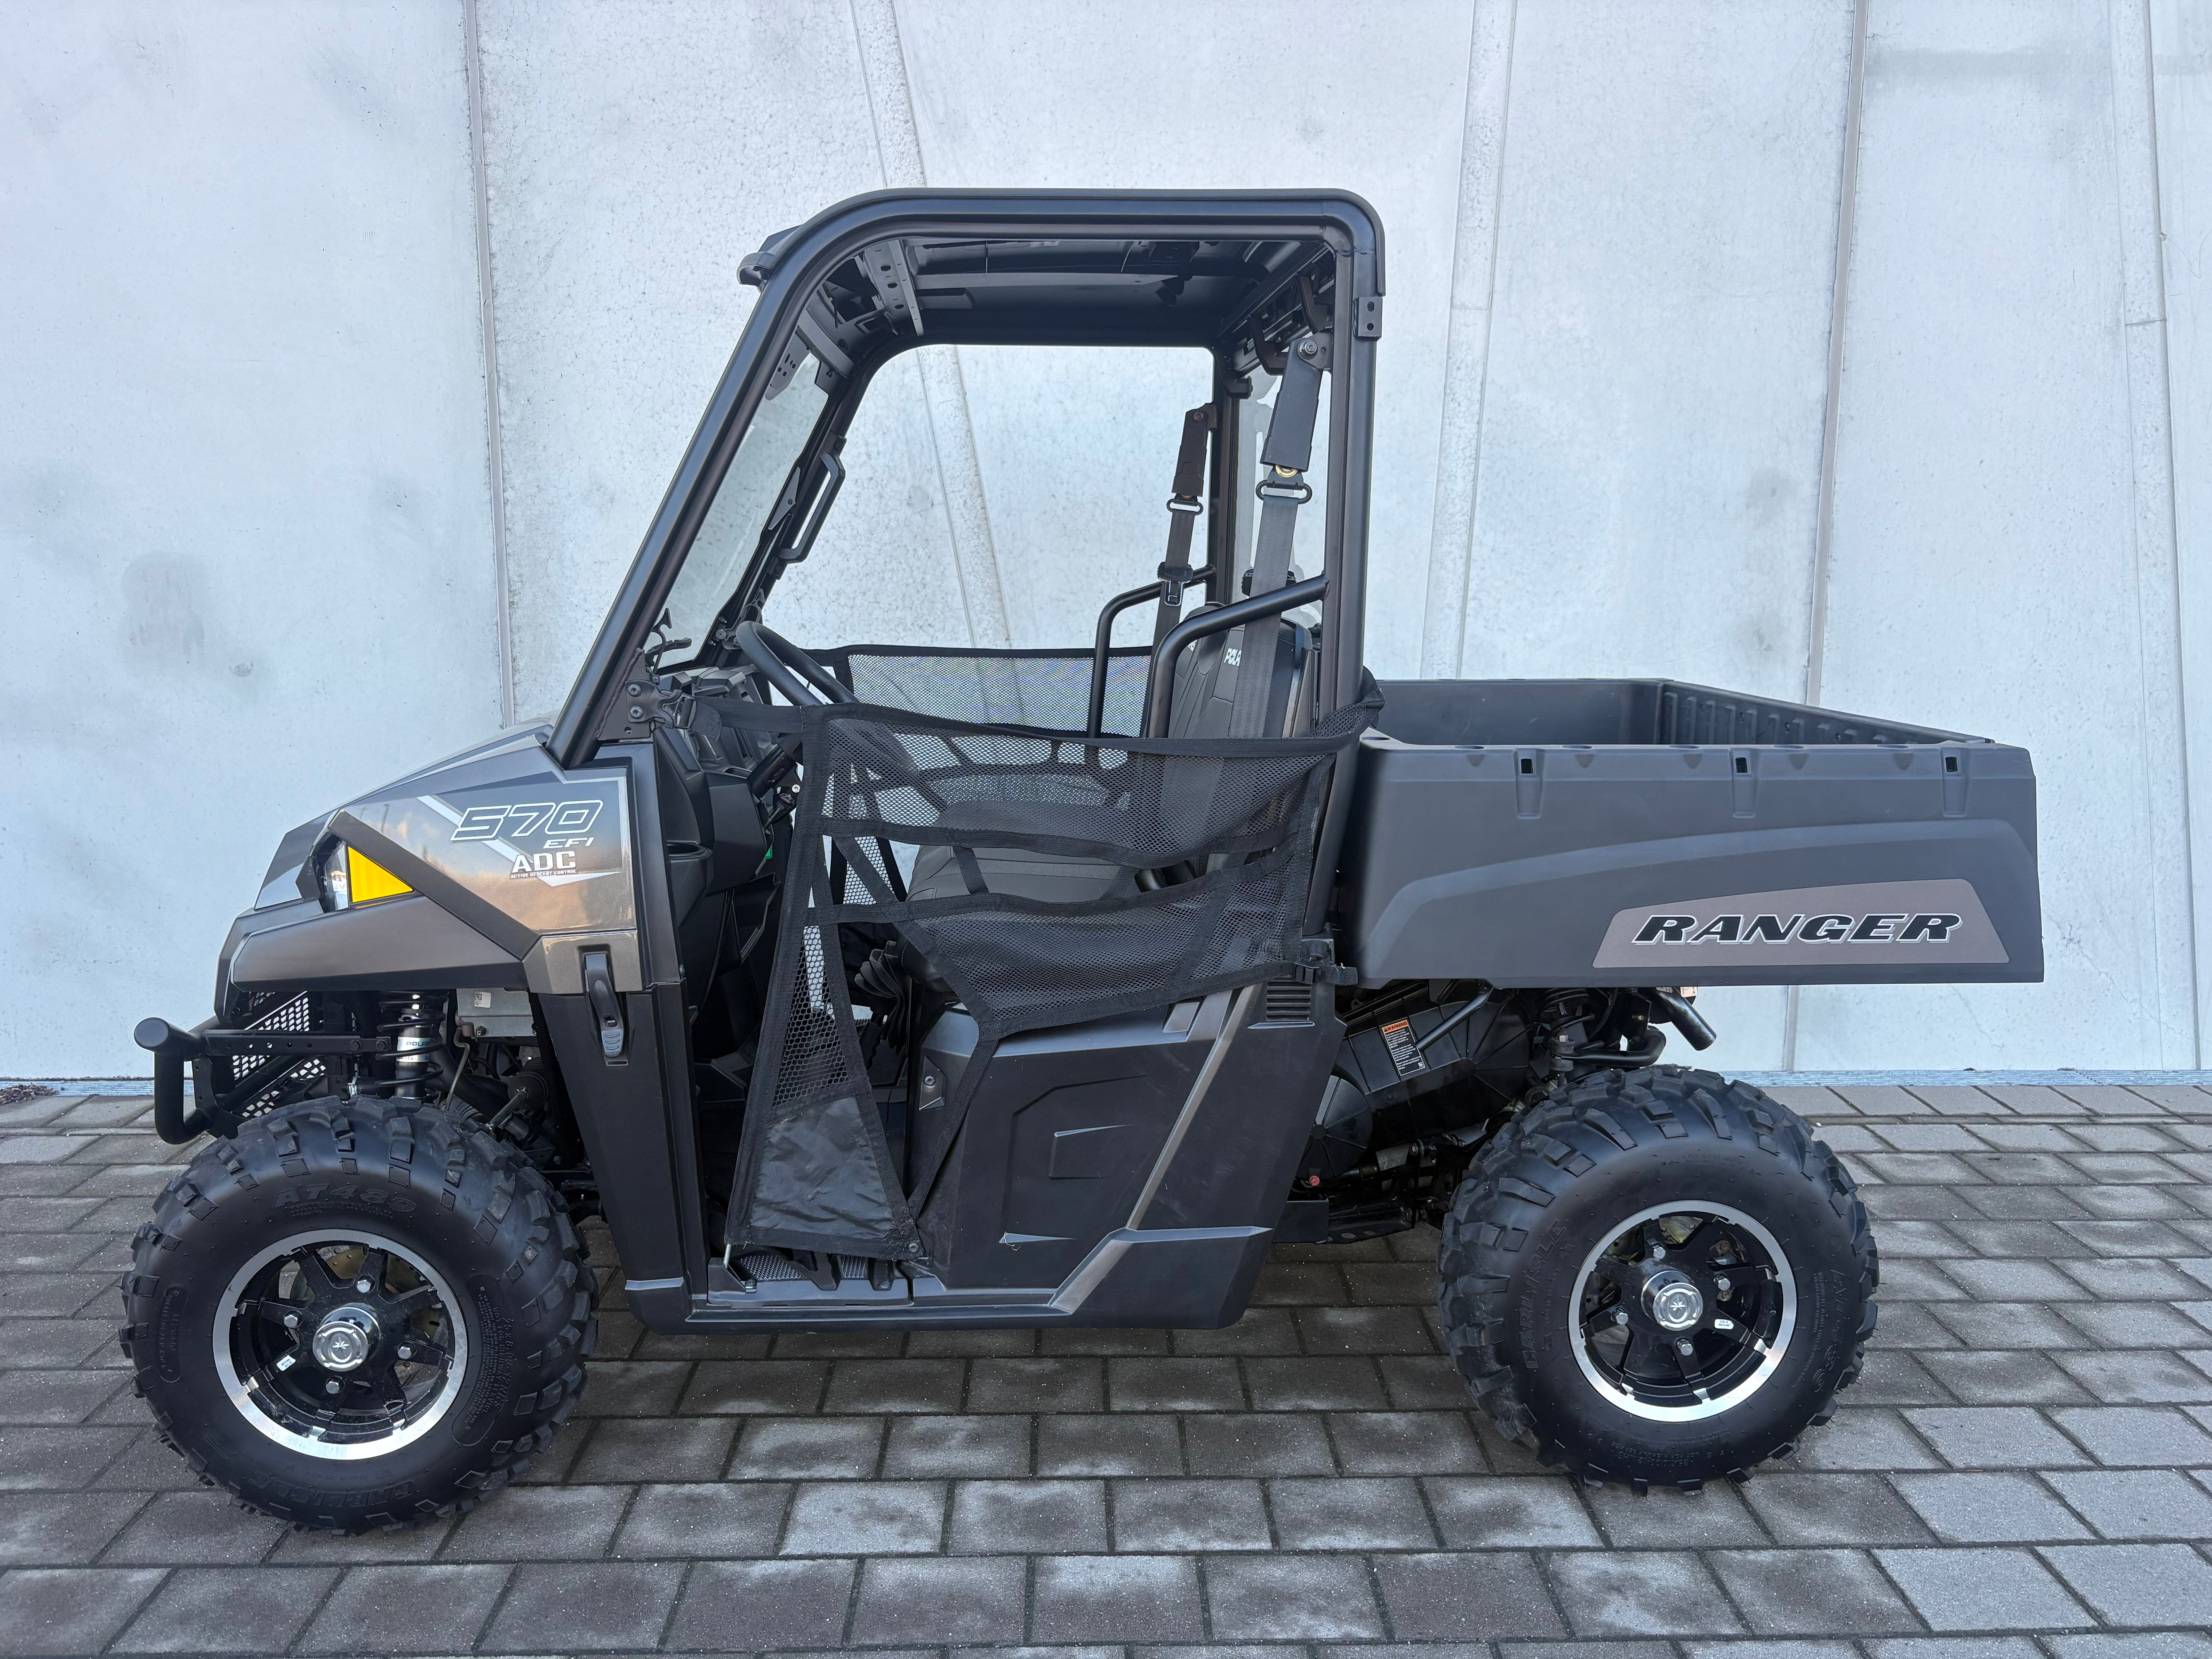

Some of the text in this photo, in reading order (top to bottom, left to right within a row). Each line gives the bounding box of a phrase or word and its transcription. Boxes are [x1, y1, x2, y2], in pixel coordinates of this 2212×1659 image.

[1224, 648, 1242, 666] POLA
[450, 800, 603, 841] 570
[543, 837, 594, 849] EFI
[512, 851, 576, 873] ADC
[1632, 913, 1963, 945] RANGER
[1387, 1021, 1408, 1031] WARNING
[273, 1183, 417, 1212] AT489
[1519, 1220, 1567, 1369] CARLISLE
[249, 1470, 416, 1508] CARLISLE
